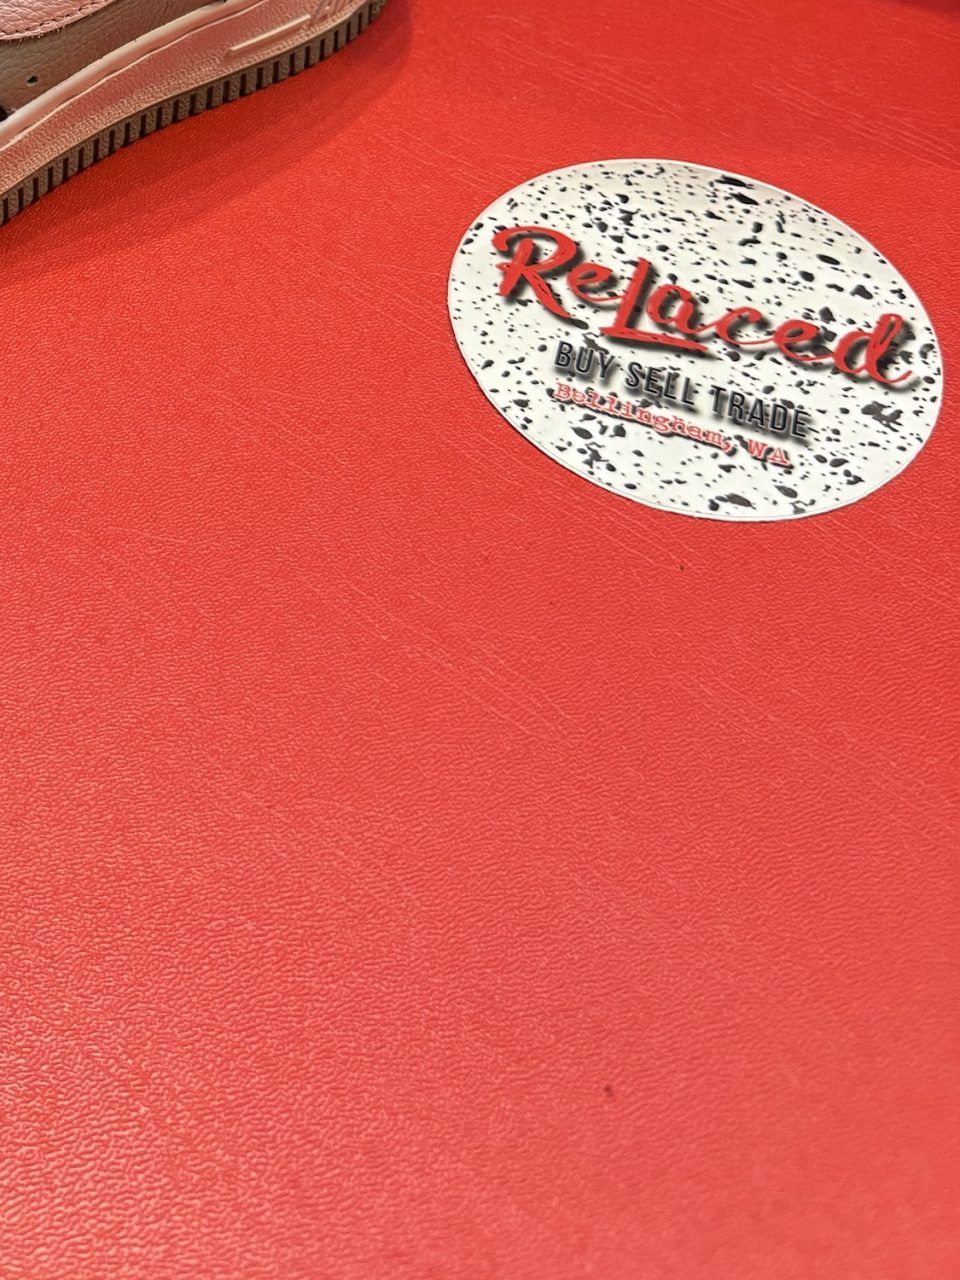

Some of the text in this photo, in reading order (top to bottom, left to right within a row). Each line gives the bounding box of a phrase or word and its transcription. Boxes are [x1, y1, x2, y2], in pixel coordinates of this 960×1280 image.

[491, 226, 913, 385] ReLaced
[554, 340, 812, 438] BUY SELL TRADE
[554, 382, 793, 466] Bellingham, WA
